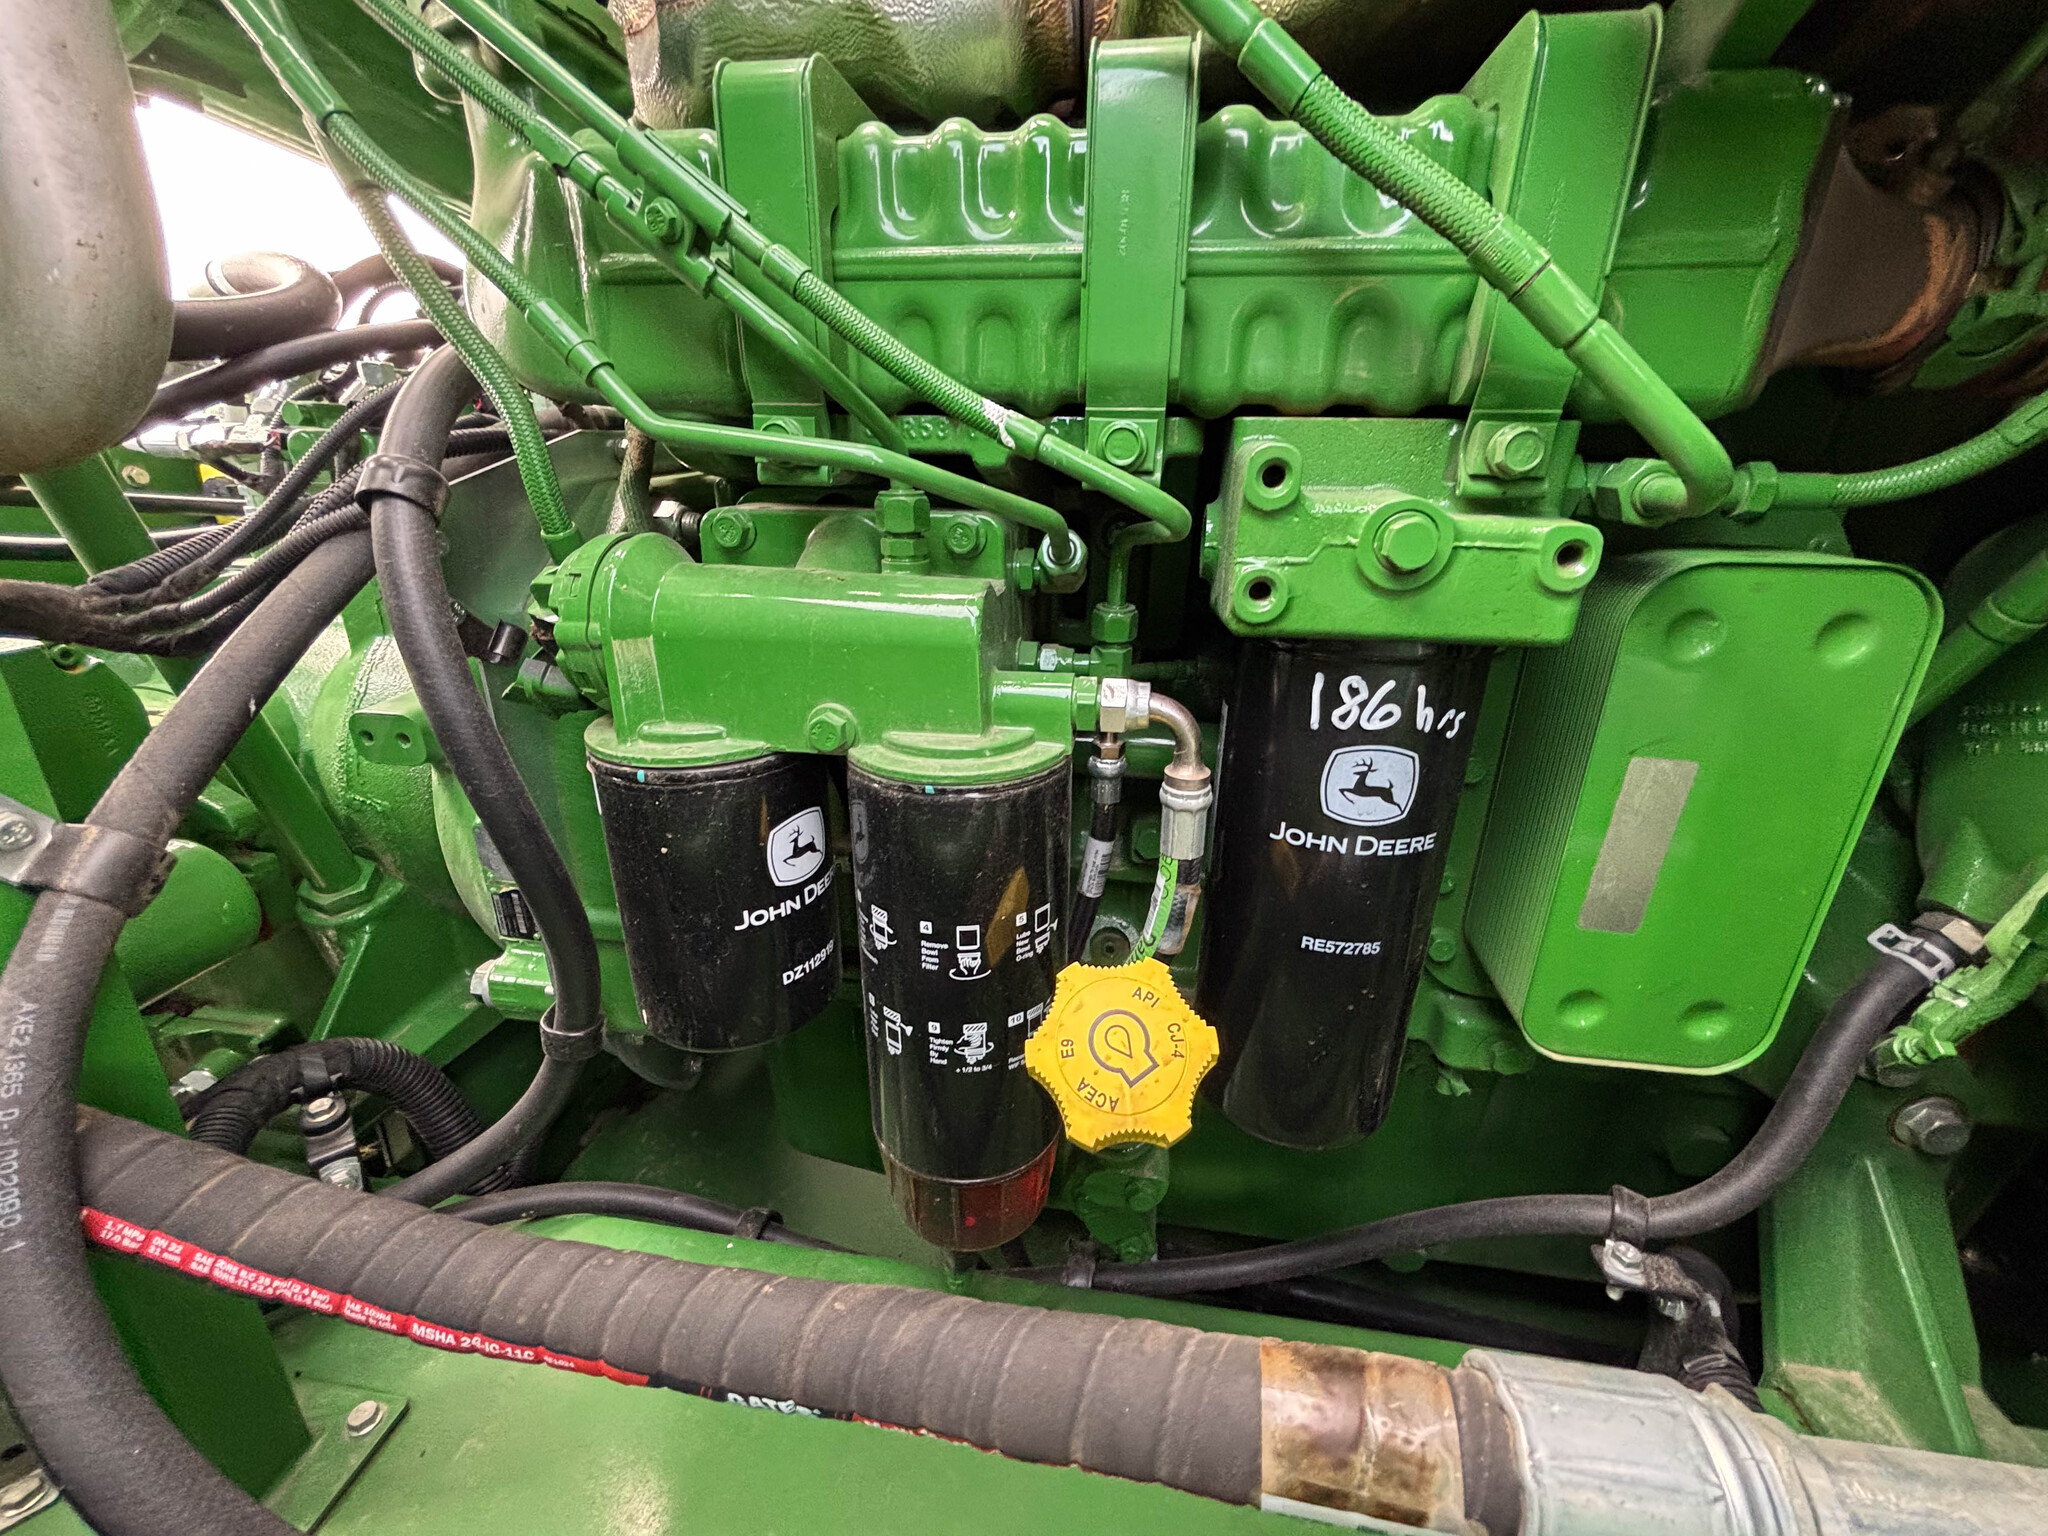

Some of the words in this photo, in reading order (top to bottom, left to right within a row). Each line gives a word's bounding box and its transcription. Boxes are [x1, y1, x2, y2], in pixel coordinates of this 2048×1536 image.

[1309, 671, 1402, 731] 186
[1415, 684, 1467, 739] hrs
[1268, 821, 1349, 855] JOHN
[1354, 831, 1438, 857] DEERE
[734, 894, 802, 932] JOHN
[920, 940, 949, 950] Remove
[921, 947, 939, 956] Bowl
[1300, 935, 1382, 956] RE572785
[921, 955, 940, 964] From
[921, 962, 940, 971] Filter
[1131, 986, 1160, 1008] API
[1166, 1022, 1185, 1060] CJ-4
[929, 1036, 954, 1046] Tighten
[929, 1043, 950, 1053] Firmly
[1060, 1038, 1075, 1060] E9
[1075, 1076, 1120, 1113] ACEA
[122, 1226, 146, 1242] MPa
[411, 1322, 457, 1347] MSHA
